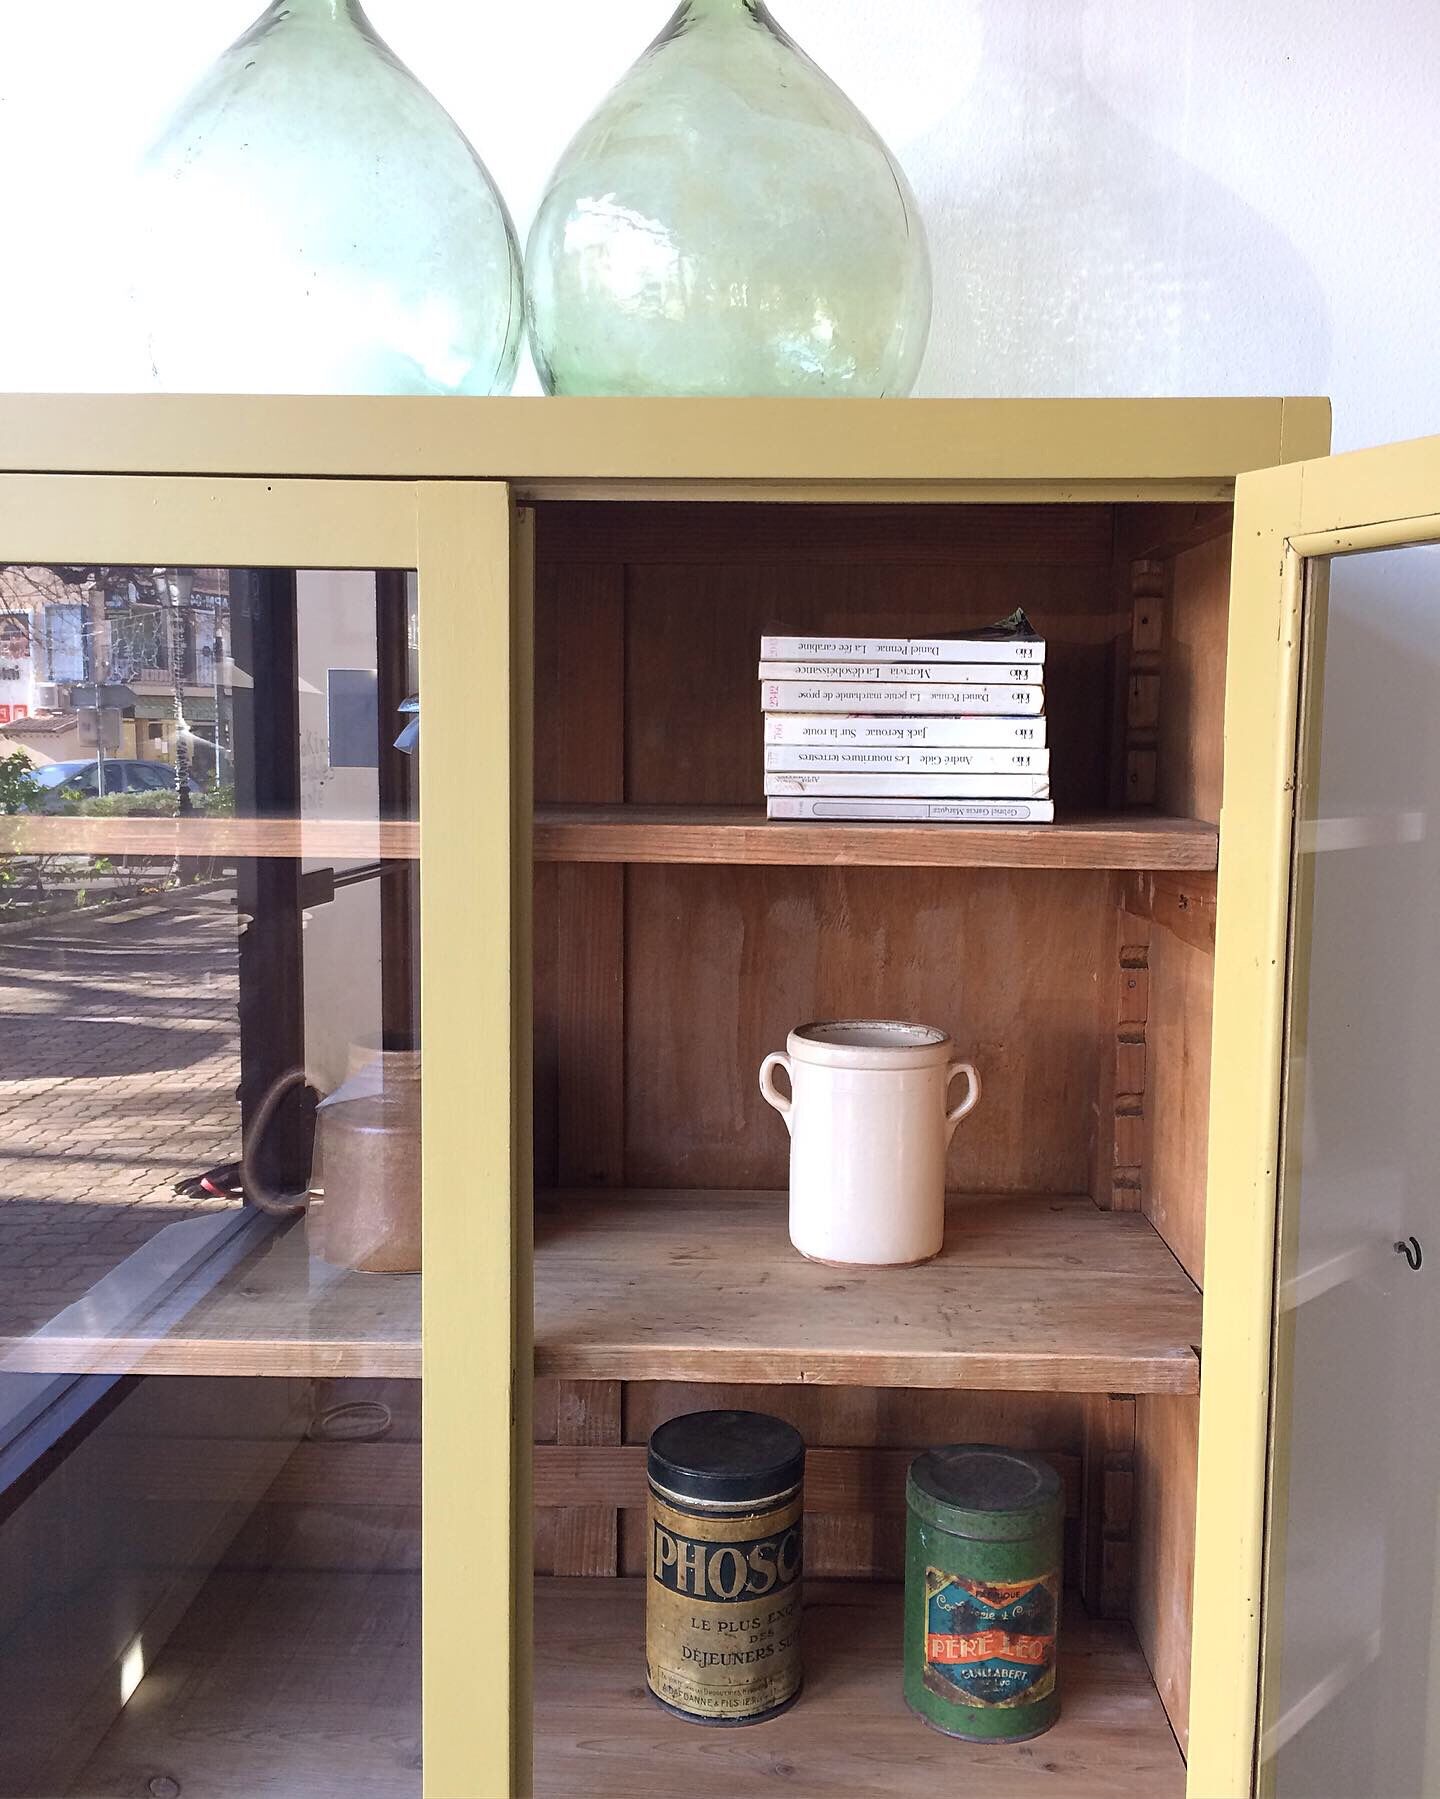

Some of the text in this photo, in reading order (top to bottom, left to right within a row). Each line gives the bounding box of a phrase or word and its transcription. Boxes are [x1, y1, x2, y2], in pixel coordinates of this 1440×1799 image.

[798, 642, 1033, 658] folio Daniel Pennac La fée carabine
[795, 666, 862, 678] désobéissance
[862, 667, 880, 678] La
[1009, 669, 1029, 680] folio
[798, 689, 1030, 704] folio Daniel Pennac La petite marchande de prose
[803, 727, 1034, 739] folio Jack Kerouac Sur la route
[798, 753, 1031, 767] folio André Gide Les nourritures terrestres
[691, 1617, 711, 1631] LE
[718, 1617, 761, 1633] PLUS
